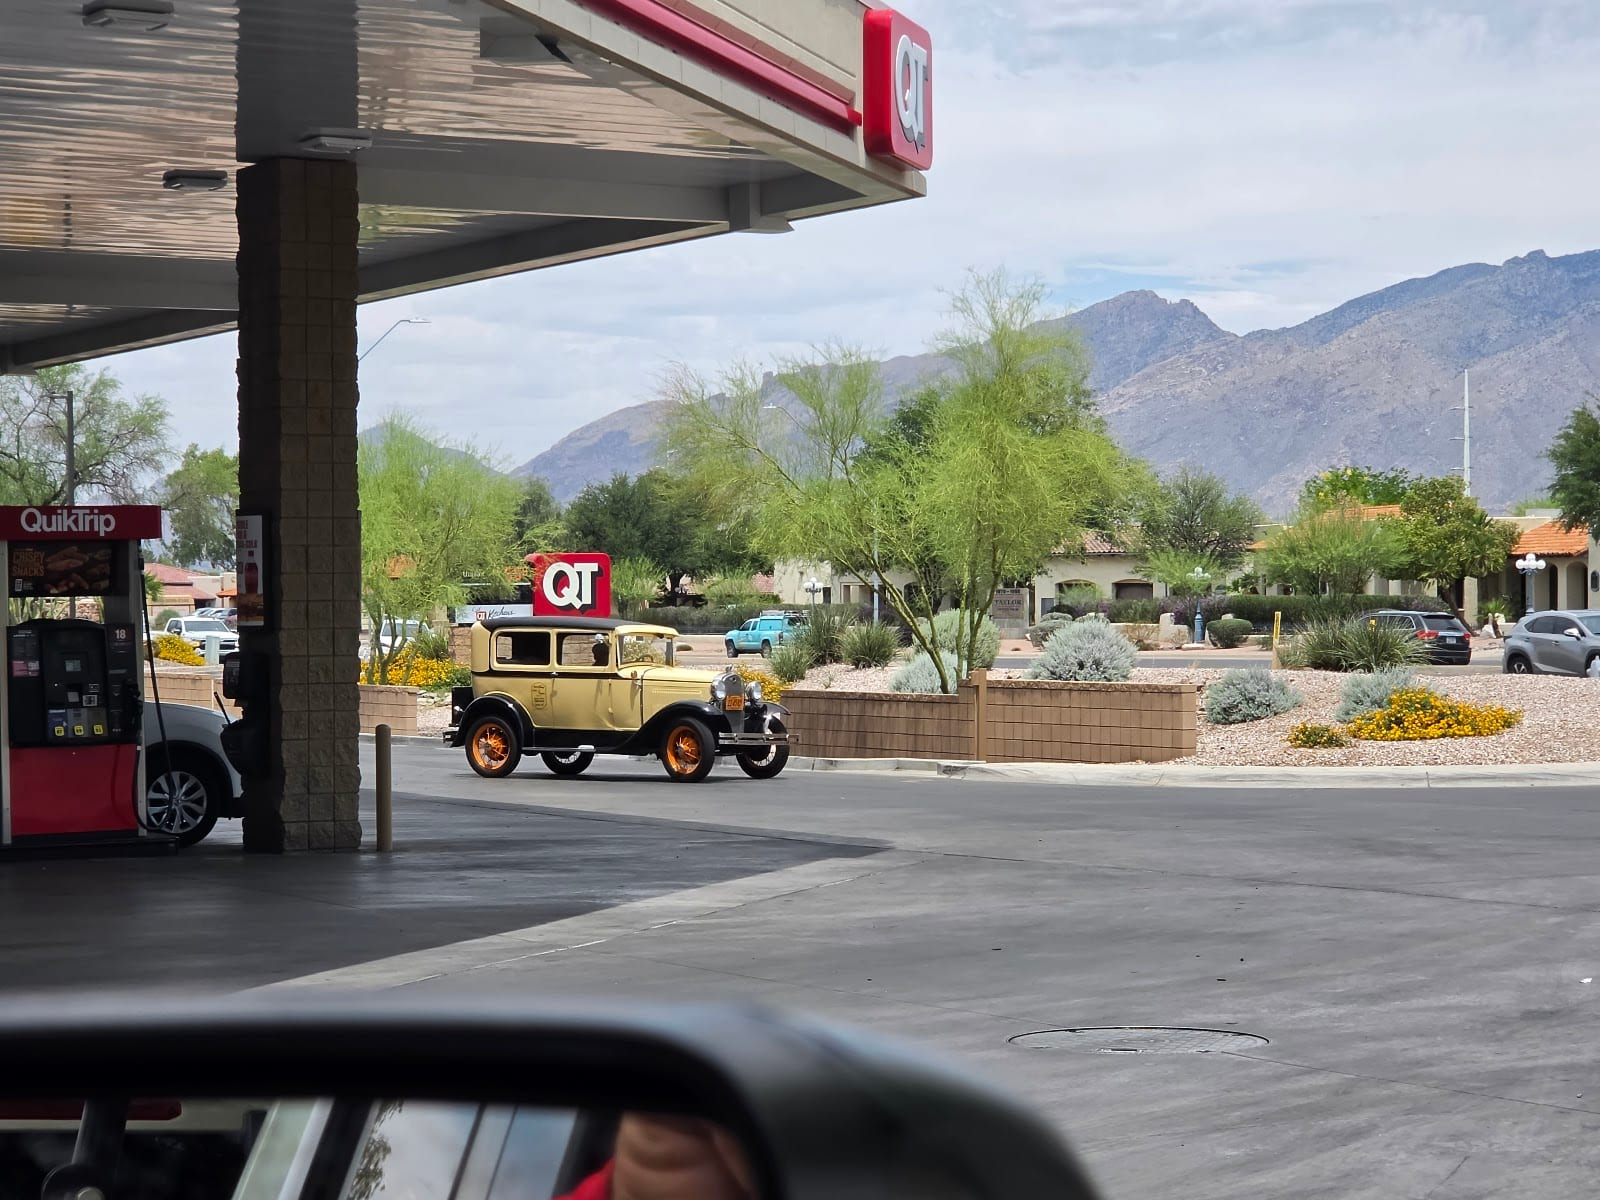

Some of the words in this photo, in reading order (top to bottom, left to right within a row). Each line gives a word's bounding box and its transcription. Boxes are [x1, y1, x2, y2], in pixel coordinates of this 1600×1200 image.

[895, 34, 928, 142] QT
[20, 507, 116, 537] QuikTrip
[13, 552, 45, 564] CRISPY
[12, 565, 45, 576] SNACKS
[542, 561, 599, 610] QT
[115, 629, 126, 640] 18
